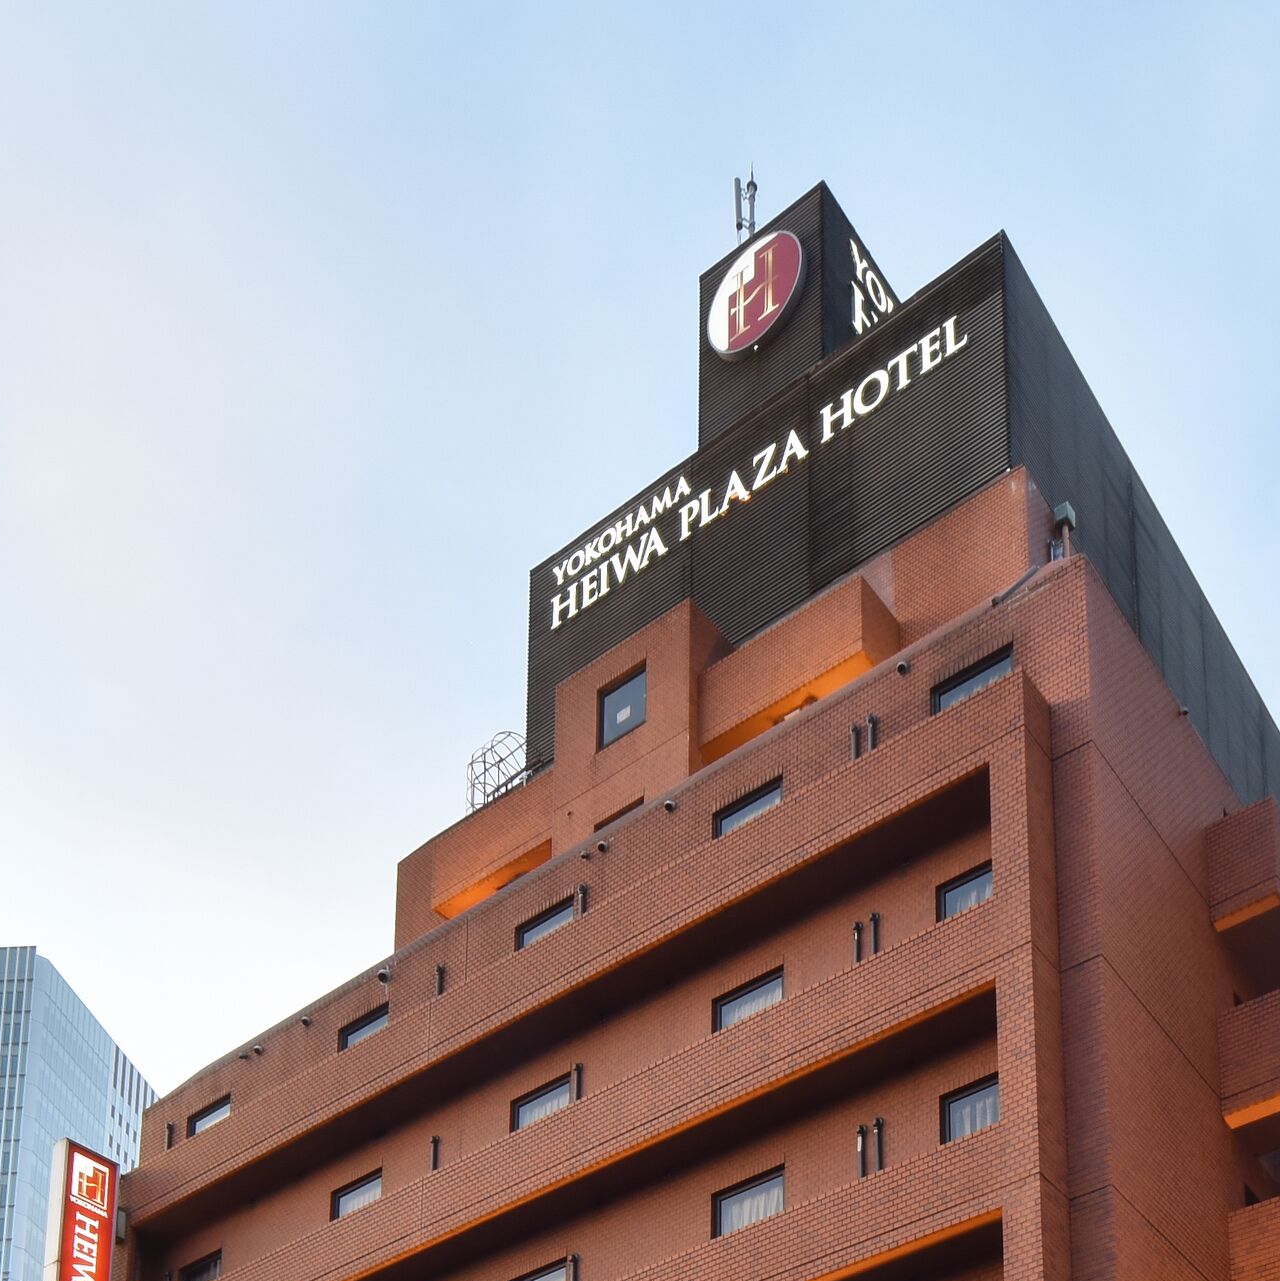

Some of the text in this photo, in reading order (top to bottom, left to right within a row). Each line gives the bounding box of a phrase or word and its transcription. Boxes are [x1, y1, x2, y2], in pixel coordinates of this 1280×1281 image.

[550, 315, 968, 631] HEIWA PLAZA HOTEL
[552, 476, 692, 586] YOKOHAMA
